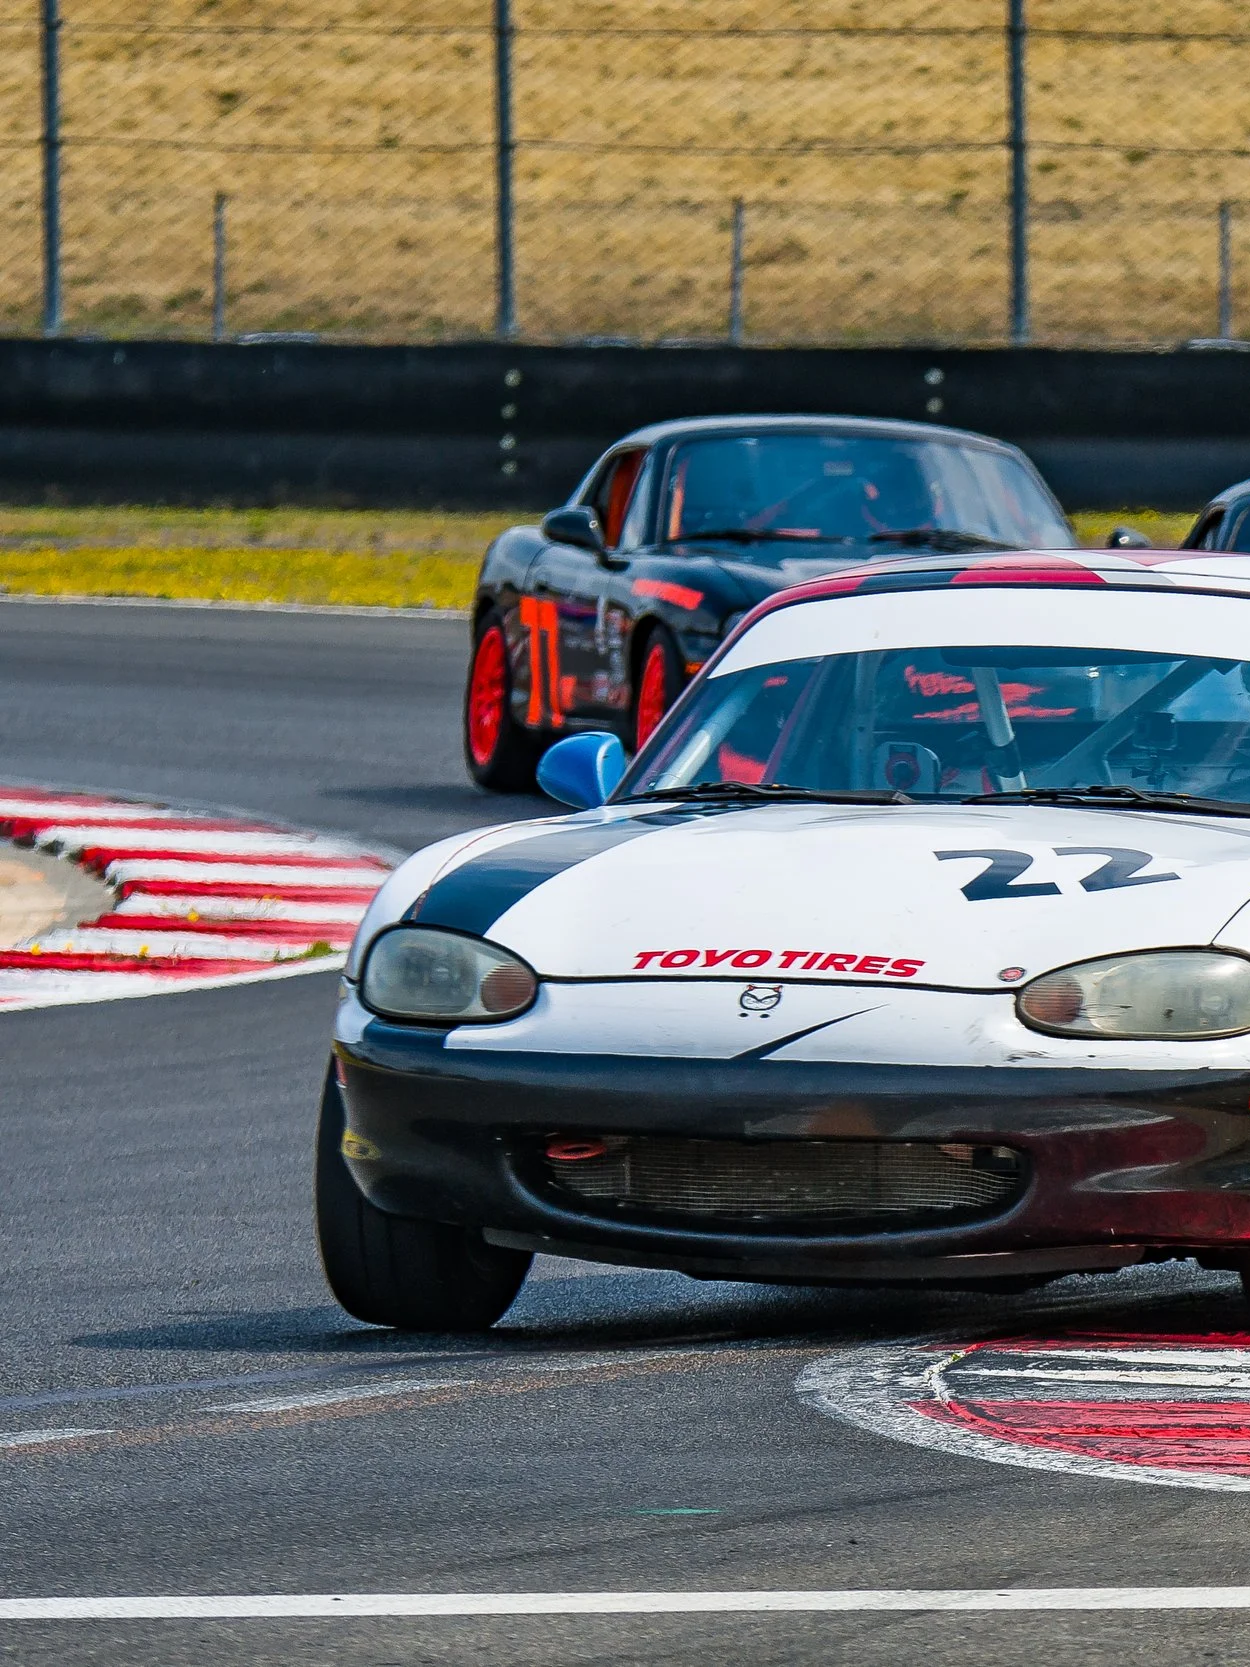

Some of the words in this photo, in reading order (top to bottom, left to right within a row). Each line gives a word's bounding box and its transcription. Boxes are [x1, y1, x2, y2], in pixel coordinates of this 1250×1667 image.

[934, 846, 1182, 902] 22
[633, 948, 774, 971] TOYO
[778, 950, 928, 978] TIRES
